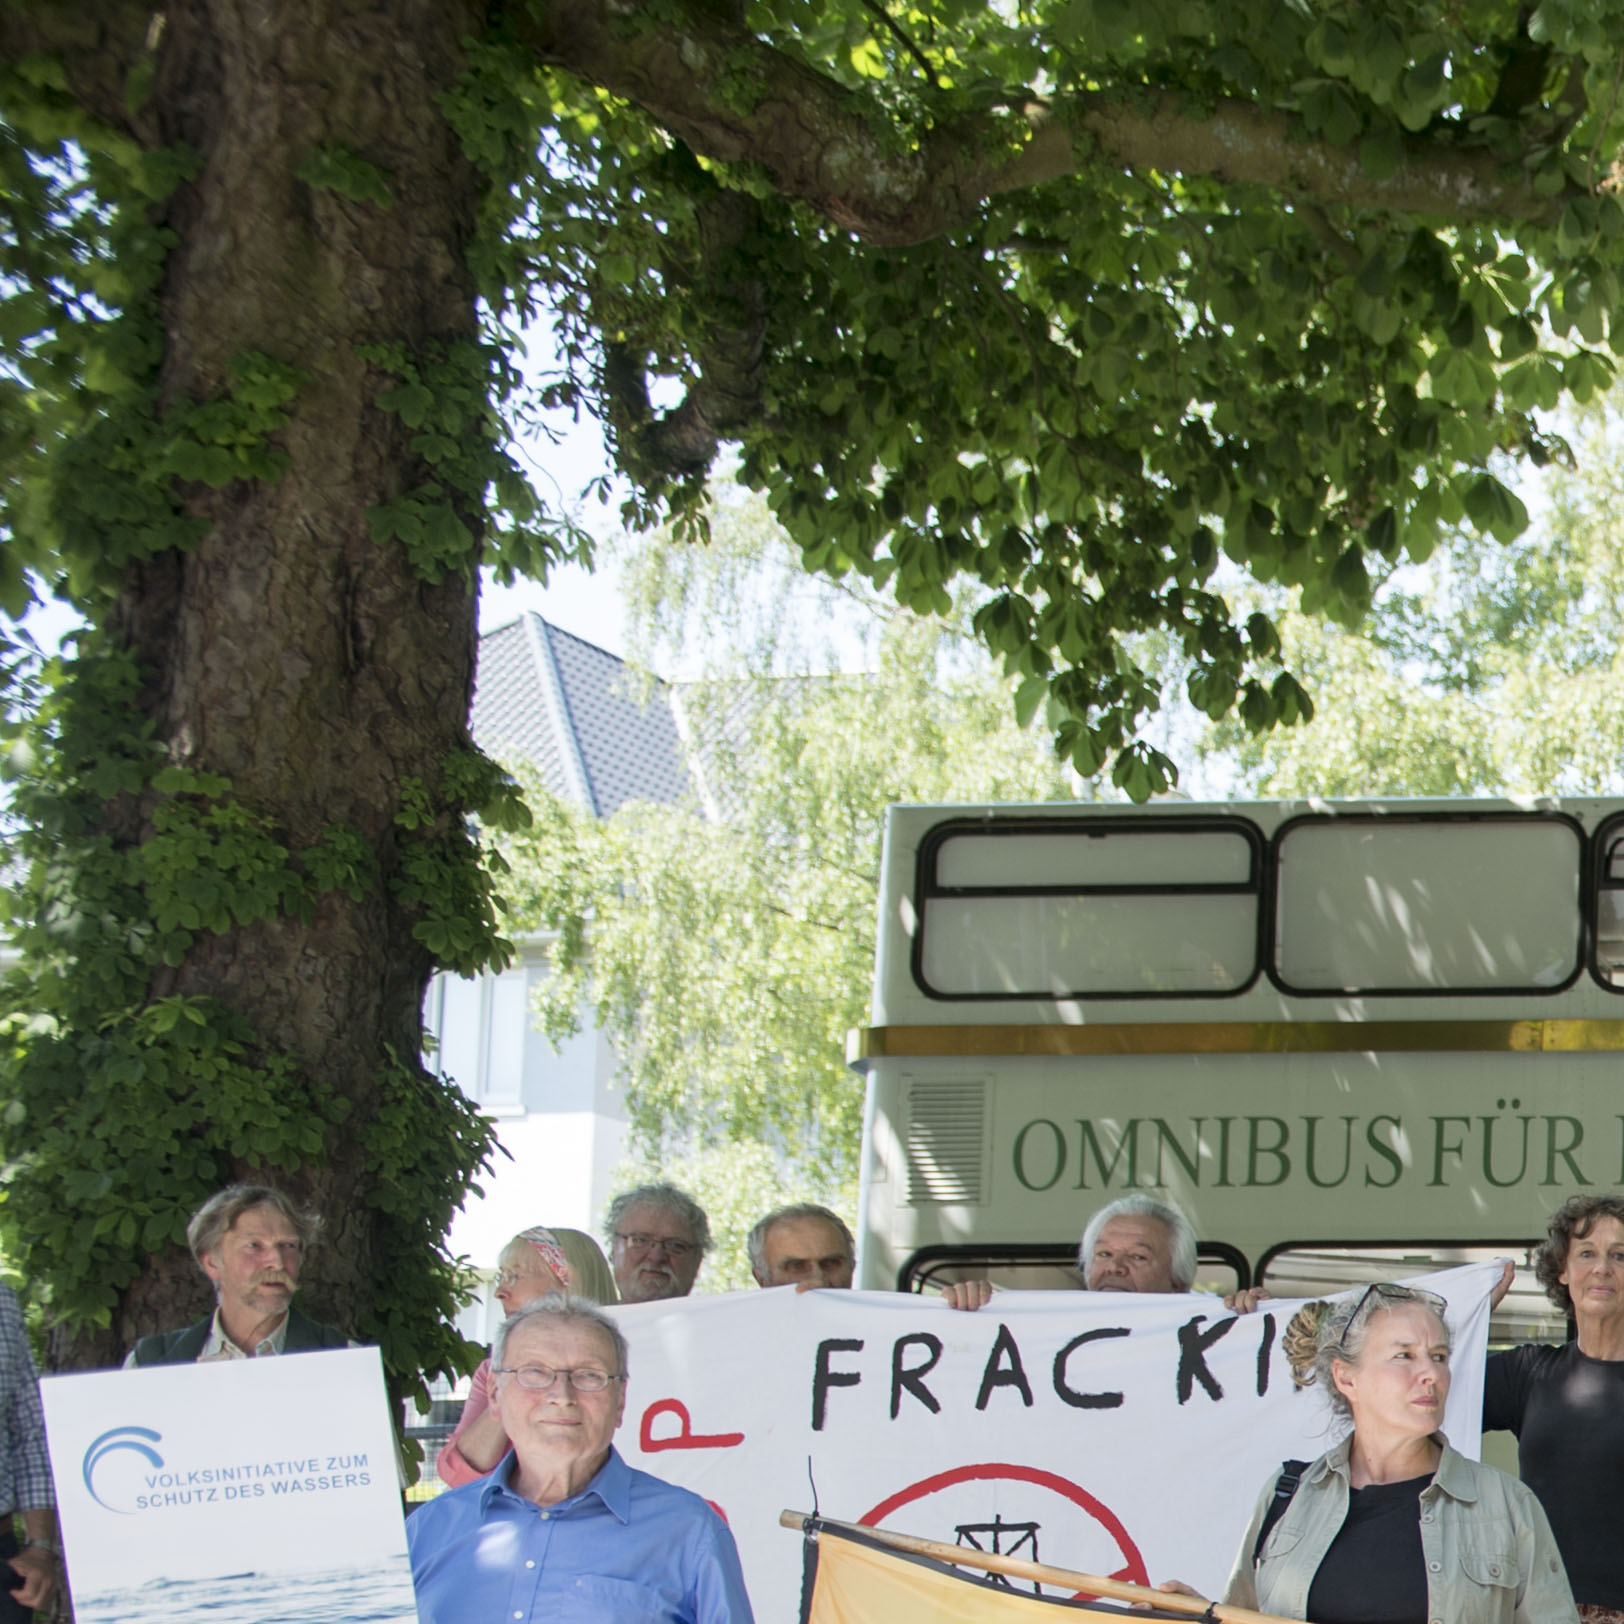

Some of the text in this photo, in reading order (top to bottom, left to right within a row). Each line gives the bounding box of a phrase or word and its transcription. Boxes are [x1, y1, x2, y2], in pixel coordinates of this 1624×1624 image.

[1012, 1116, 1403, 1191] OMNIBUS
[1432, 1098, 1595, 1188] FÜR
[812, 1312, 1302, 1431] FRACKI
[136, 1472, 371, 1510] SCHUTZ DES WASSERS
[145, 1454, 369, 1489] VOLKSINITIATIVE ZUM
